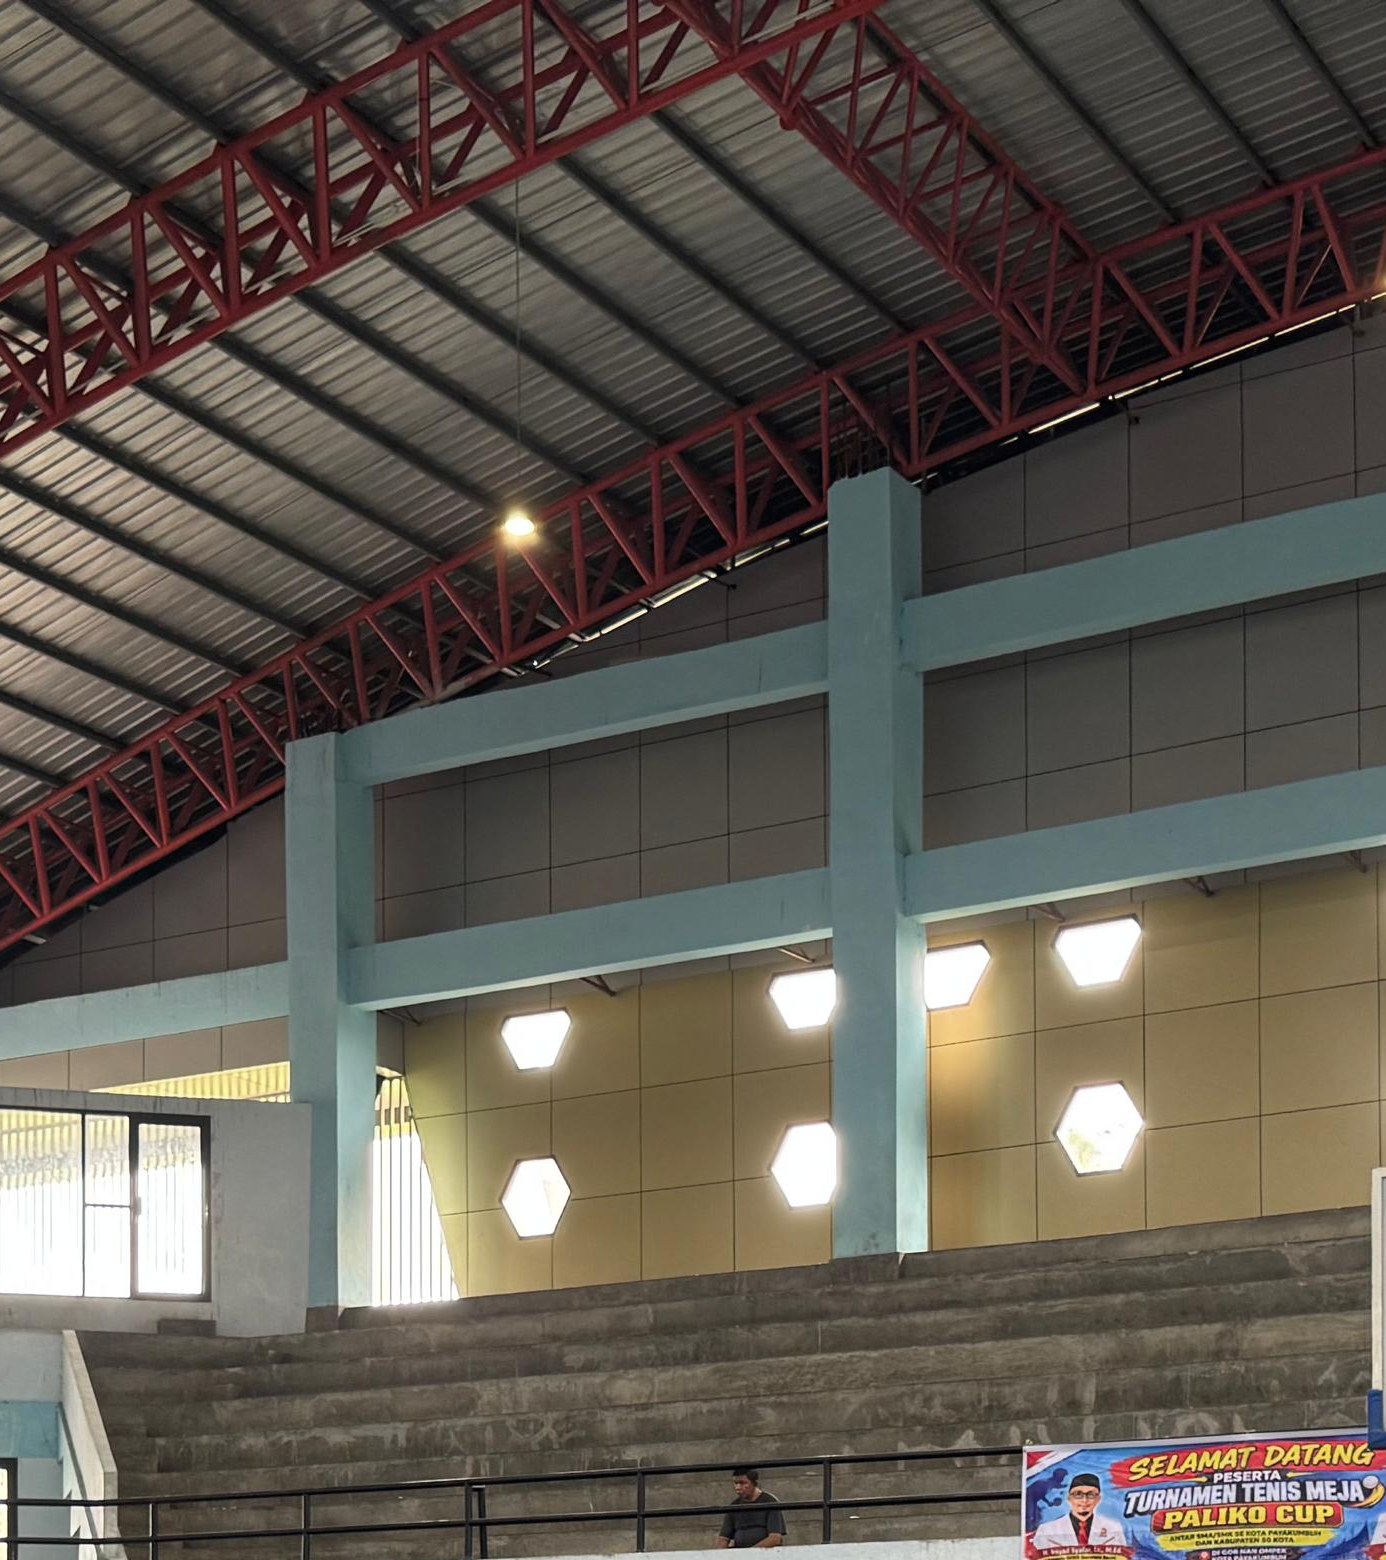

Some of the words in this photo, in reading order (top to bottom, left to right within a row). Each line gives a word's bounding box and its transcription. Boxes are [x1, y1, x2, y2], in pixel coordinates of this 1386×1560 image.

[1127, 1447, 1256, 1482] SELAMAT
[1264, 1443, 1375, 1467] DATANG
[1213, 1471, 1281, 1484] PESERTA
[1126, 1485, 1239, 1514] TURNAMEN
[1241, 1480, 1302, 1503] TENIS
[1305, 1479, 1364, 1502] MEJA
[1163, 1506, 1267, 1530] PALIKO
[1276, 1505, 1335, 1524] CUP
[1169, 1534, 1196, 1542] ANTAR
